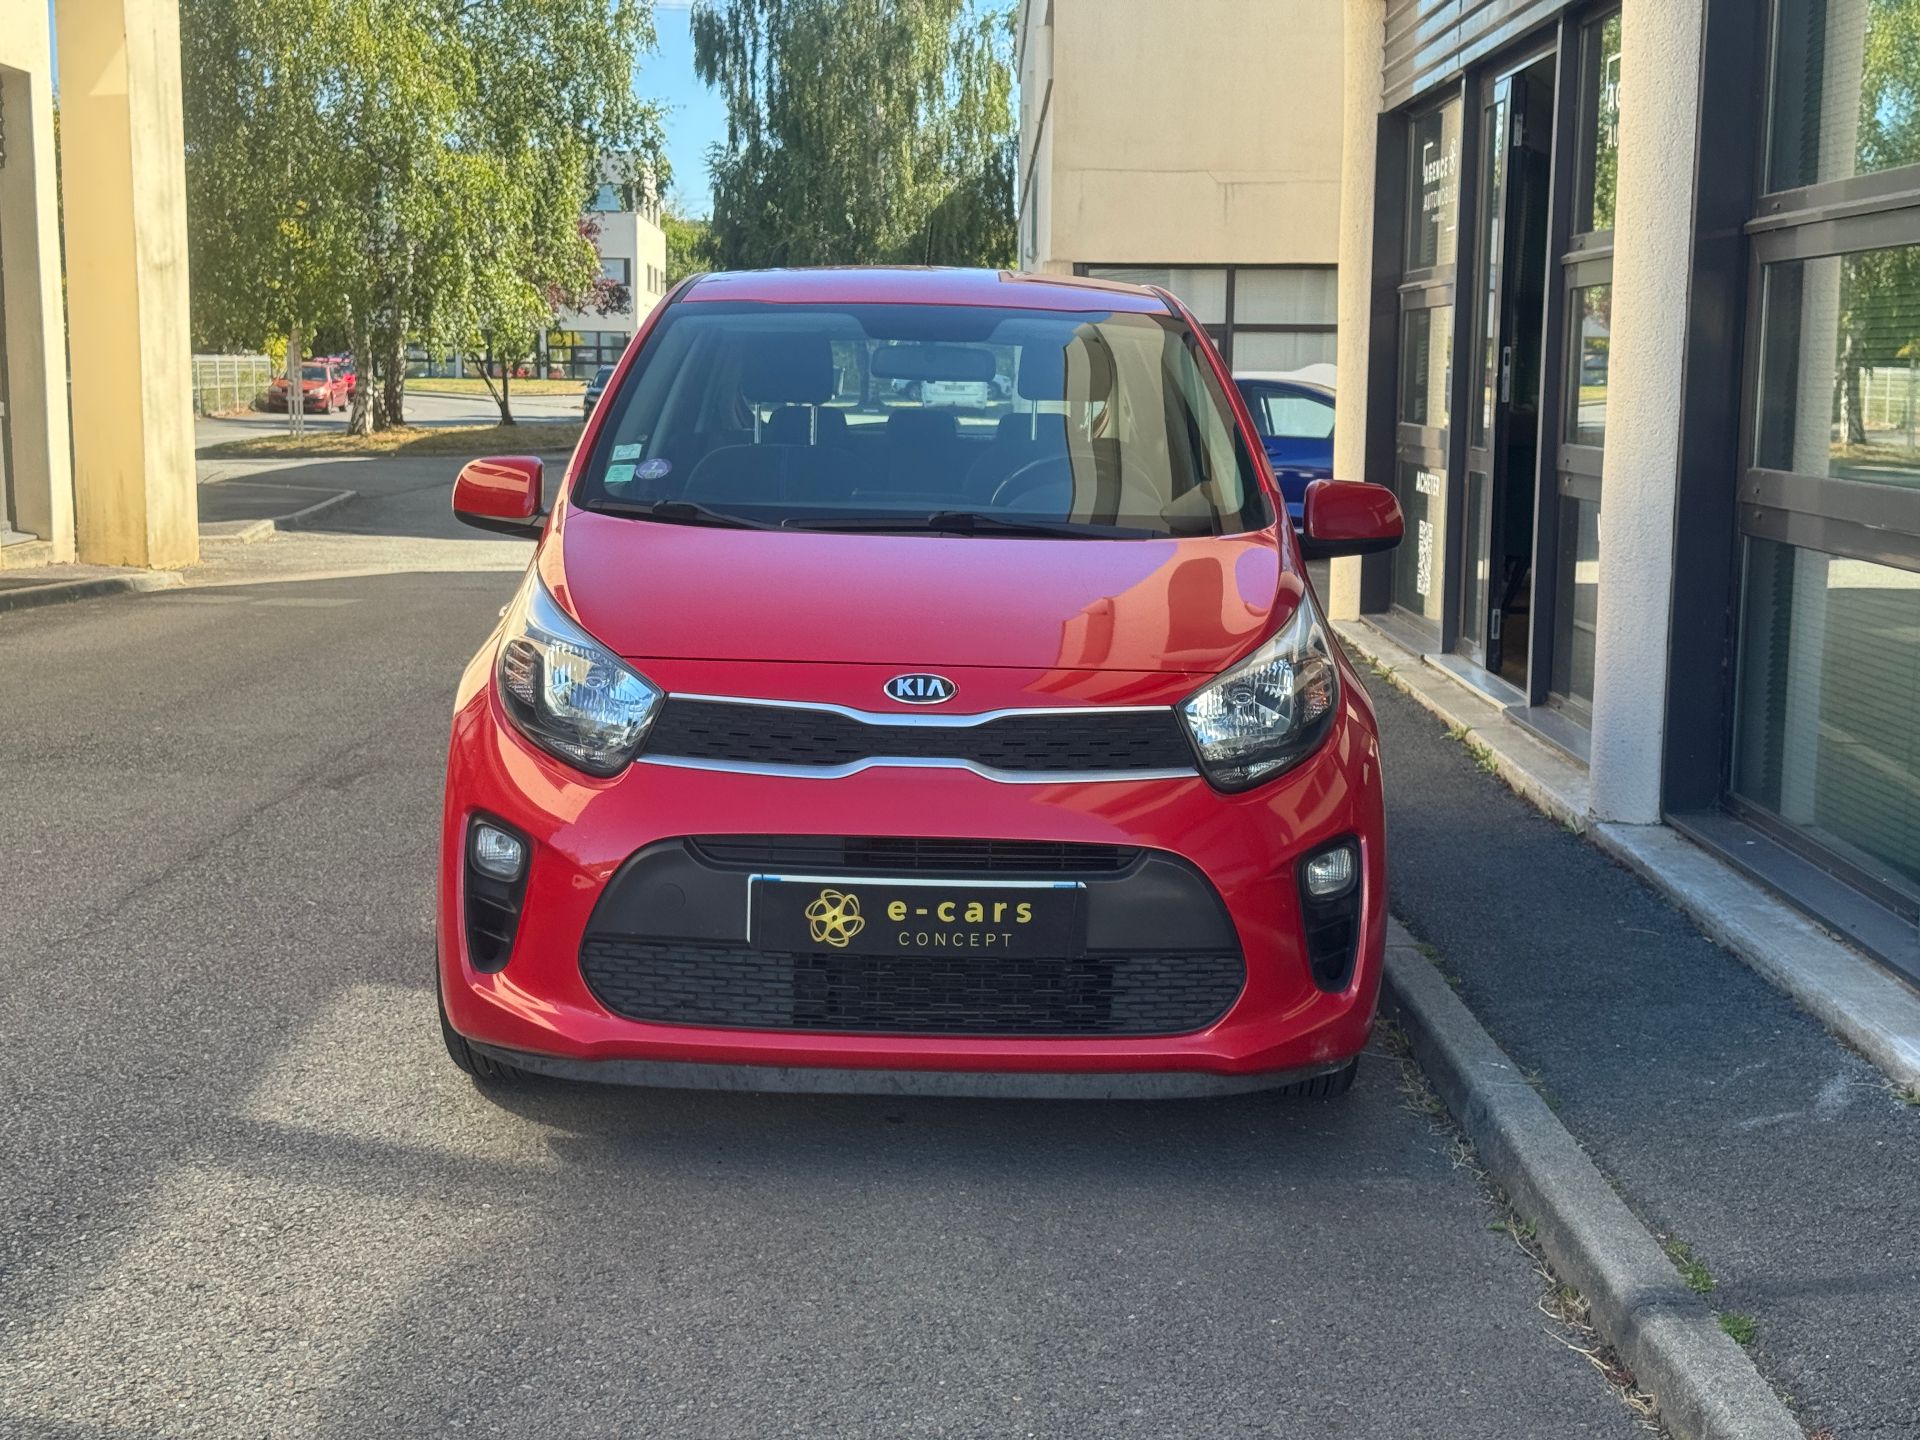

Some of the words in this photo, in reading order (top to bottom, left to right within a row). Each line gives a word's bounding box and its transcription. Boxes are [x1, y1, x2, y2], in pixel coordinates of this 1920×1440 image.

[1423, 156, 1449, 186] AGENCE
[1423, 183, 1457, 211] AUTOMOBILE
[1416, 470, 1440, 497] ACHETER
[896, 678, 946, 697] KIA
[887, 900, 1032, 924] e-cars
[898, 931, 1013, 947] CONCEPT
